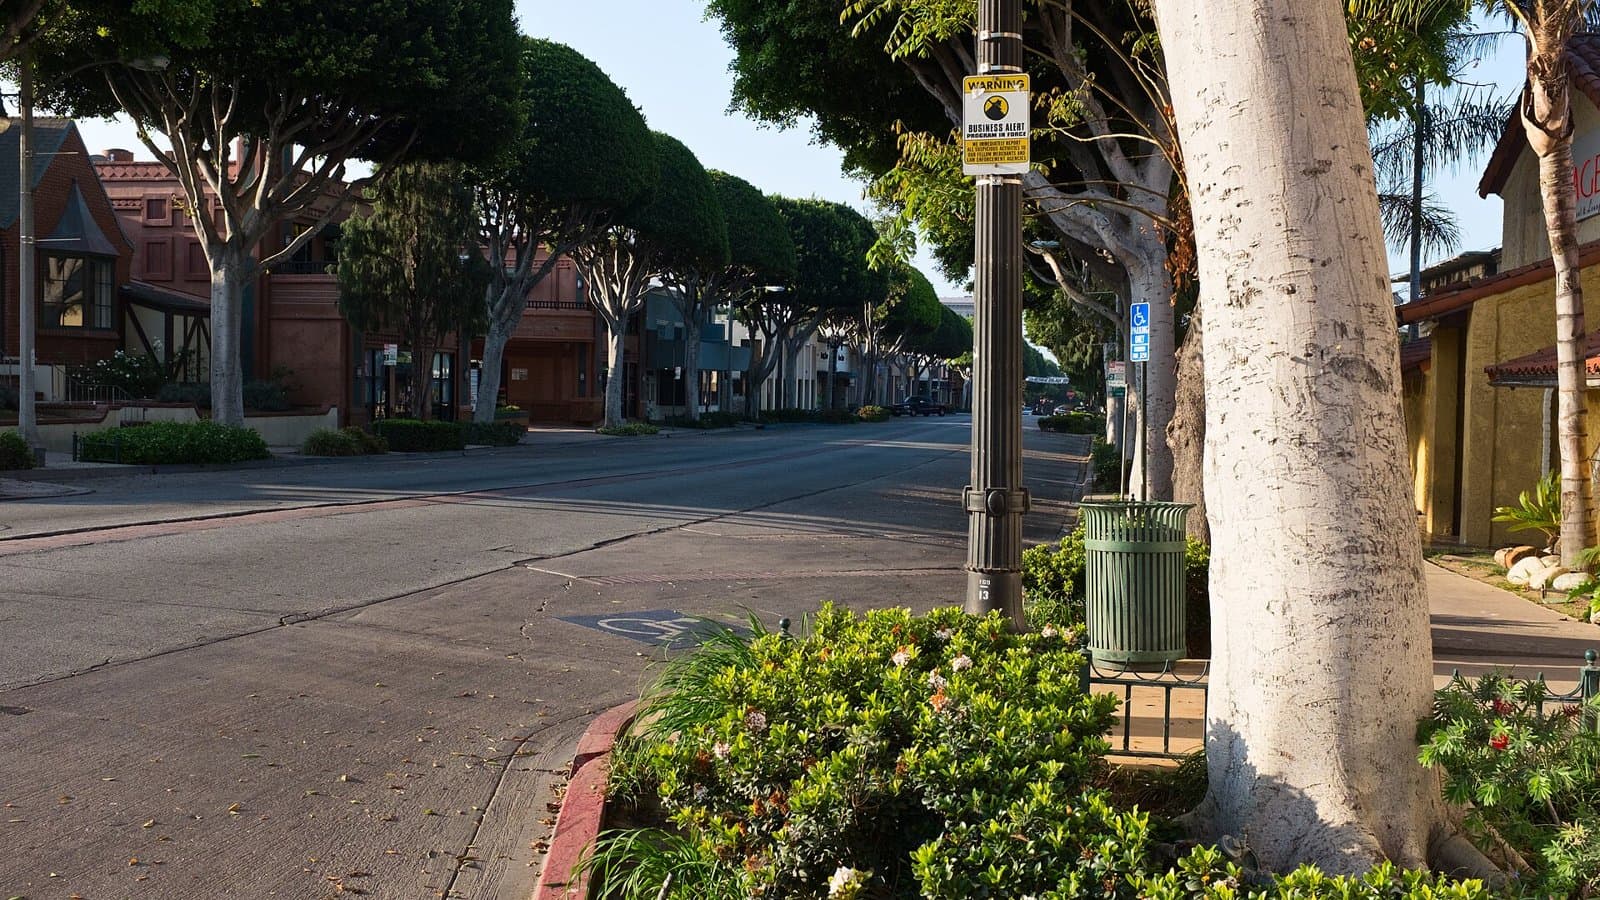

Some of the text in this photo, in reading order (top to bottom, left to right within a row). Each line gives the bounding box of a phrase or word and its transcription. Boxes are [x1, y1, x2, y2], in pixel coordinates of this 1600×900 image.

[968, 80, 1025, 90] WARNING
[968, 122, 1024, 132] BUSINESS ALERT
[979, 590, 989, 600] 13
